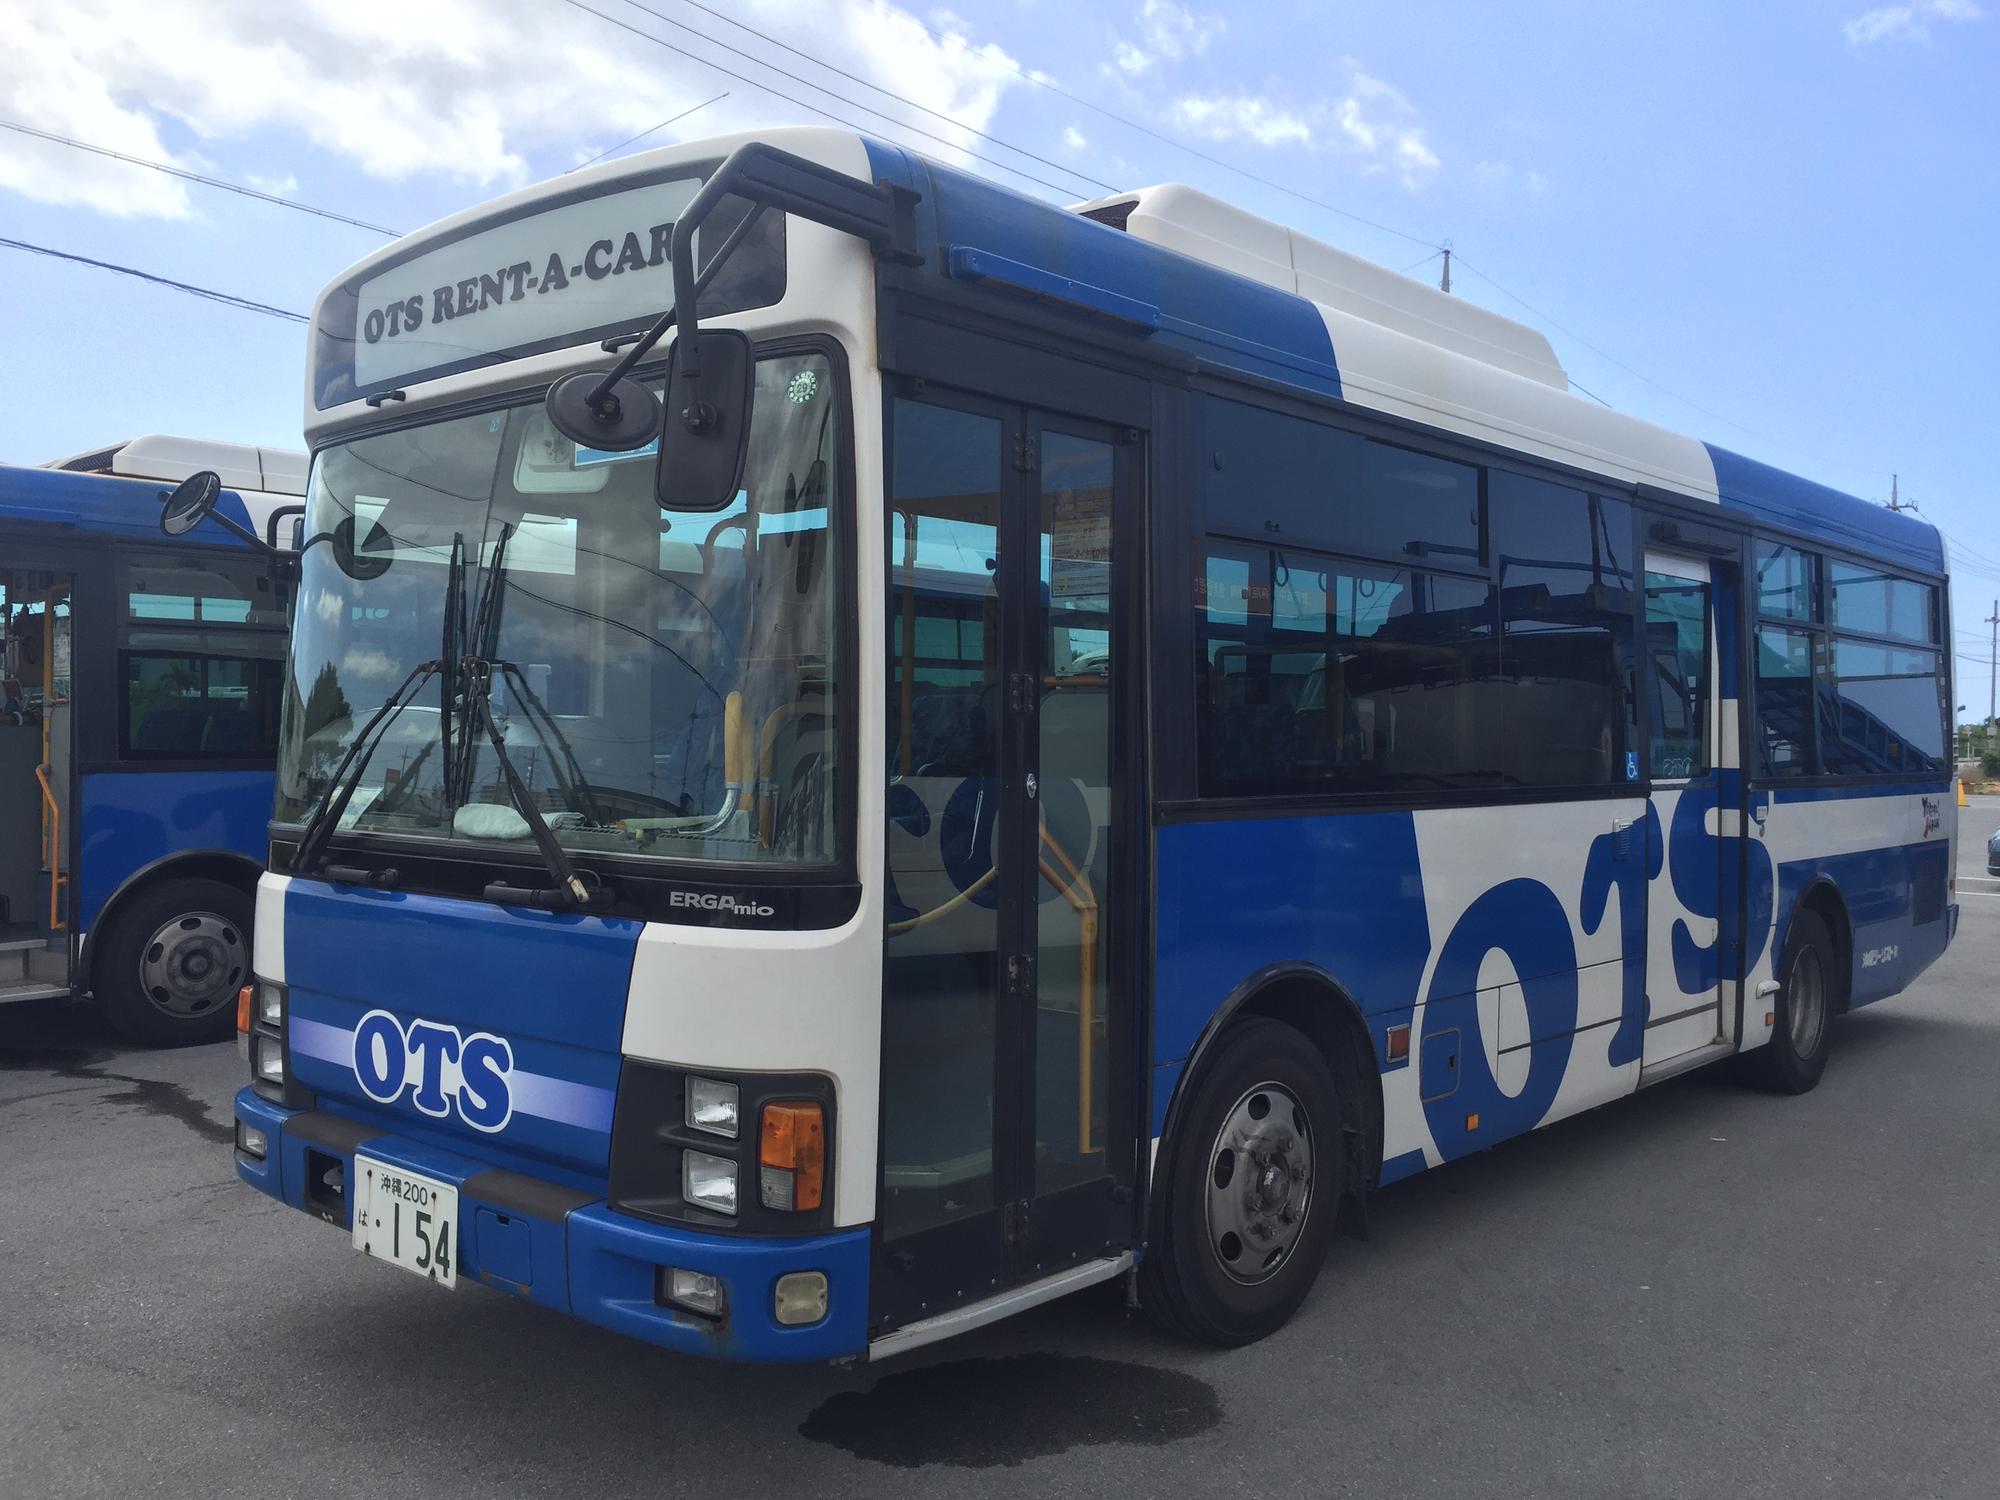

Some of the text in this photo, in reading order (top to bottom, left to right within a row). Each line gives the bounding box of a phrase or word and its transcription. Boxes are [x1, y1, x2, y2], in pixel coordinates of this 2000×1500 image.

[364, 222, 675, 344] OTS RENT-A-CAR
[352, 1009, 514, 1133] OTS
[358, 1208, 368, 1227] は
